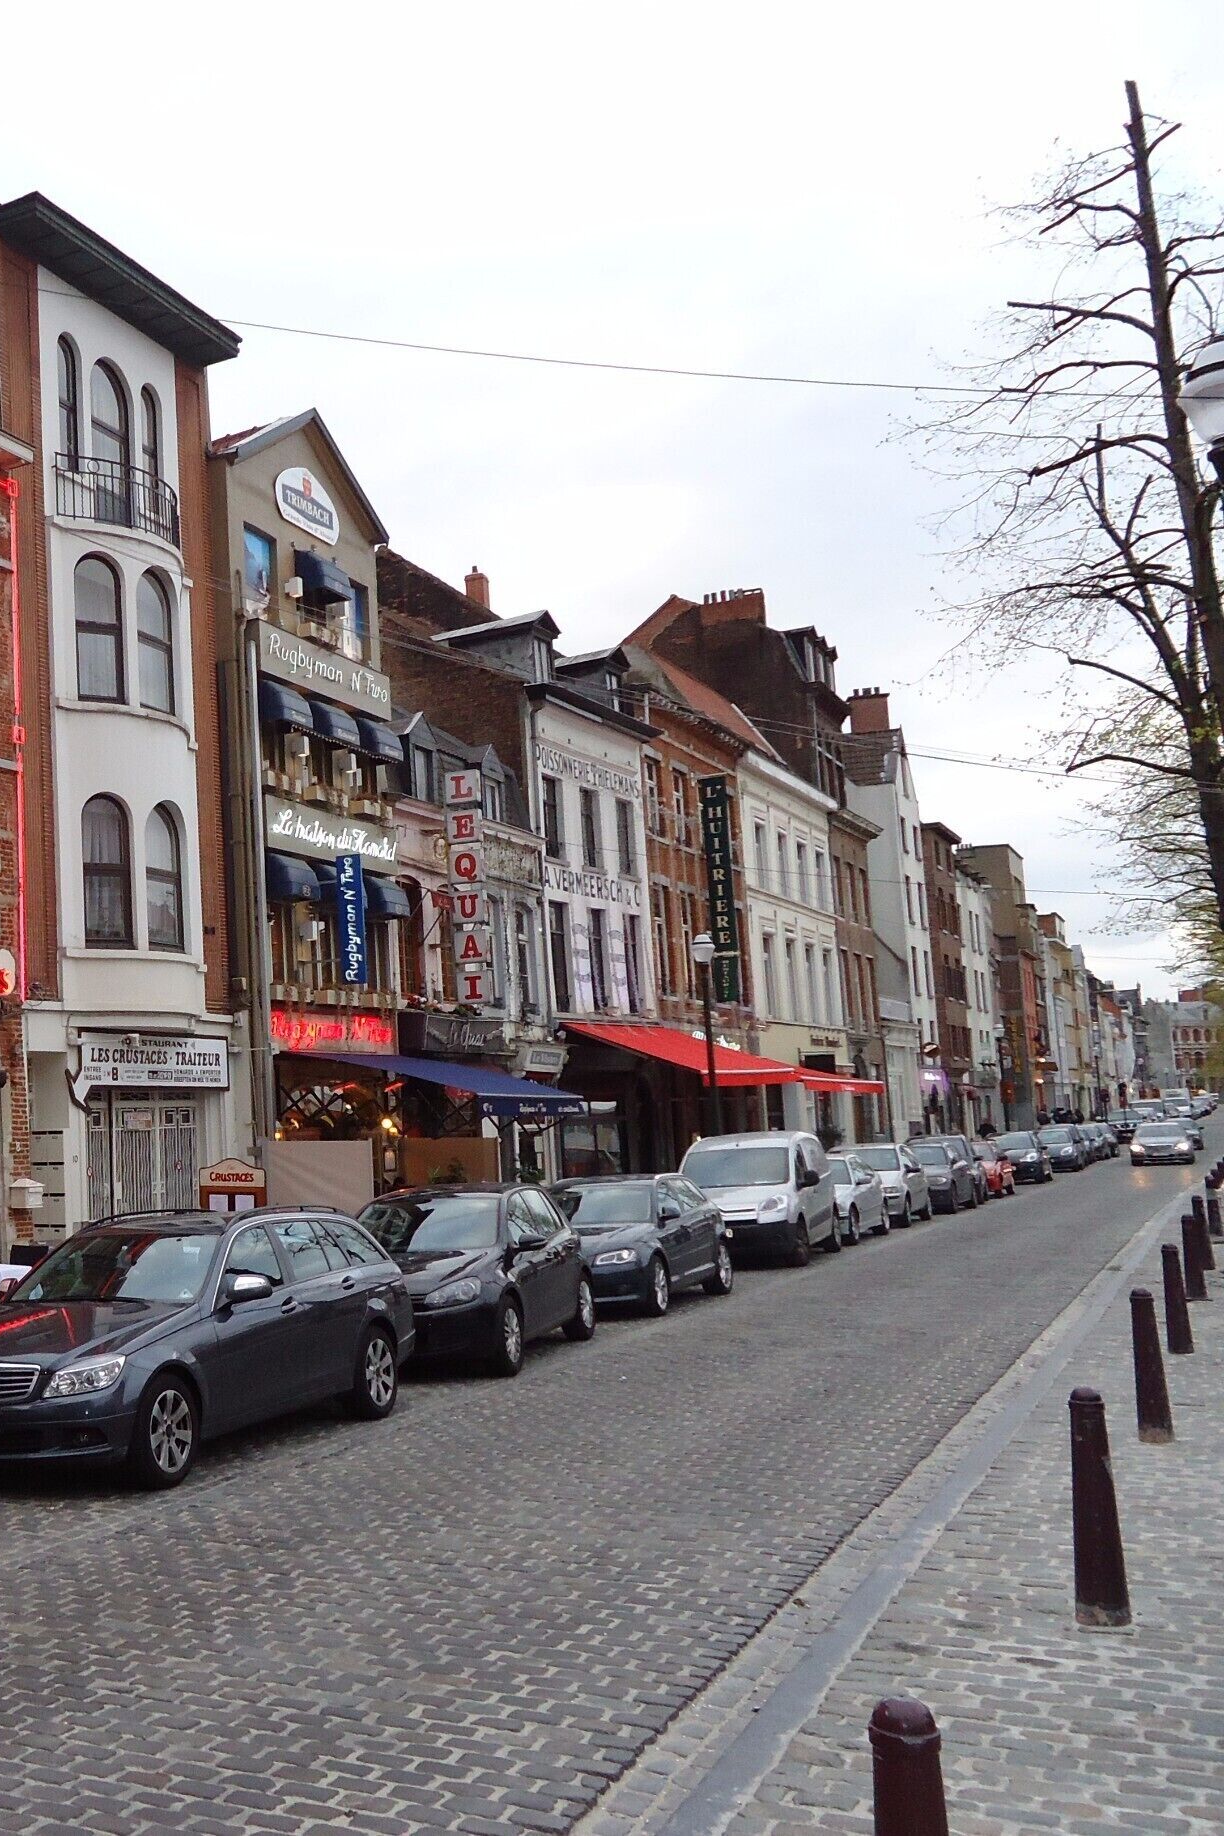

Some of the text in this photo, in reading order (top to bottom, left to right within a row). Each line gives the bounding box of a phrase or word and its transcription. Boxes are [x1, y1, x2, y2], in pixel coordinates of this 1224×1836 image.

[285, 489, 331, 526] TRIMBACH
[269, 633, 343, 683] Rugbyman
[363, 672, 388, 703] Two
[450, 775, 484, 1000] LE QUAI
[344, 904, 364, 983] Rugbyman
[91, 1047, 110, 1063] LES
[176, 1052, 221, 1067] TRAITEUR
[112, 1067, 119, 1081] 8
